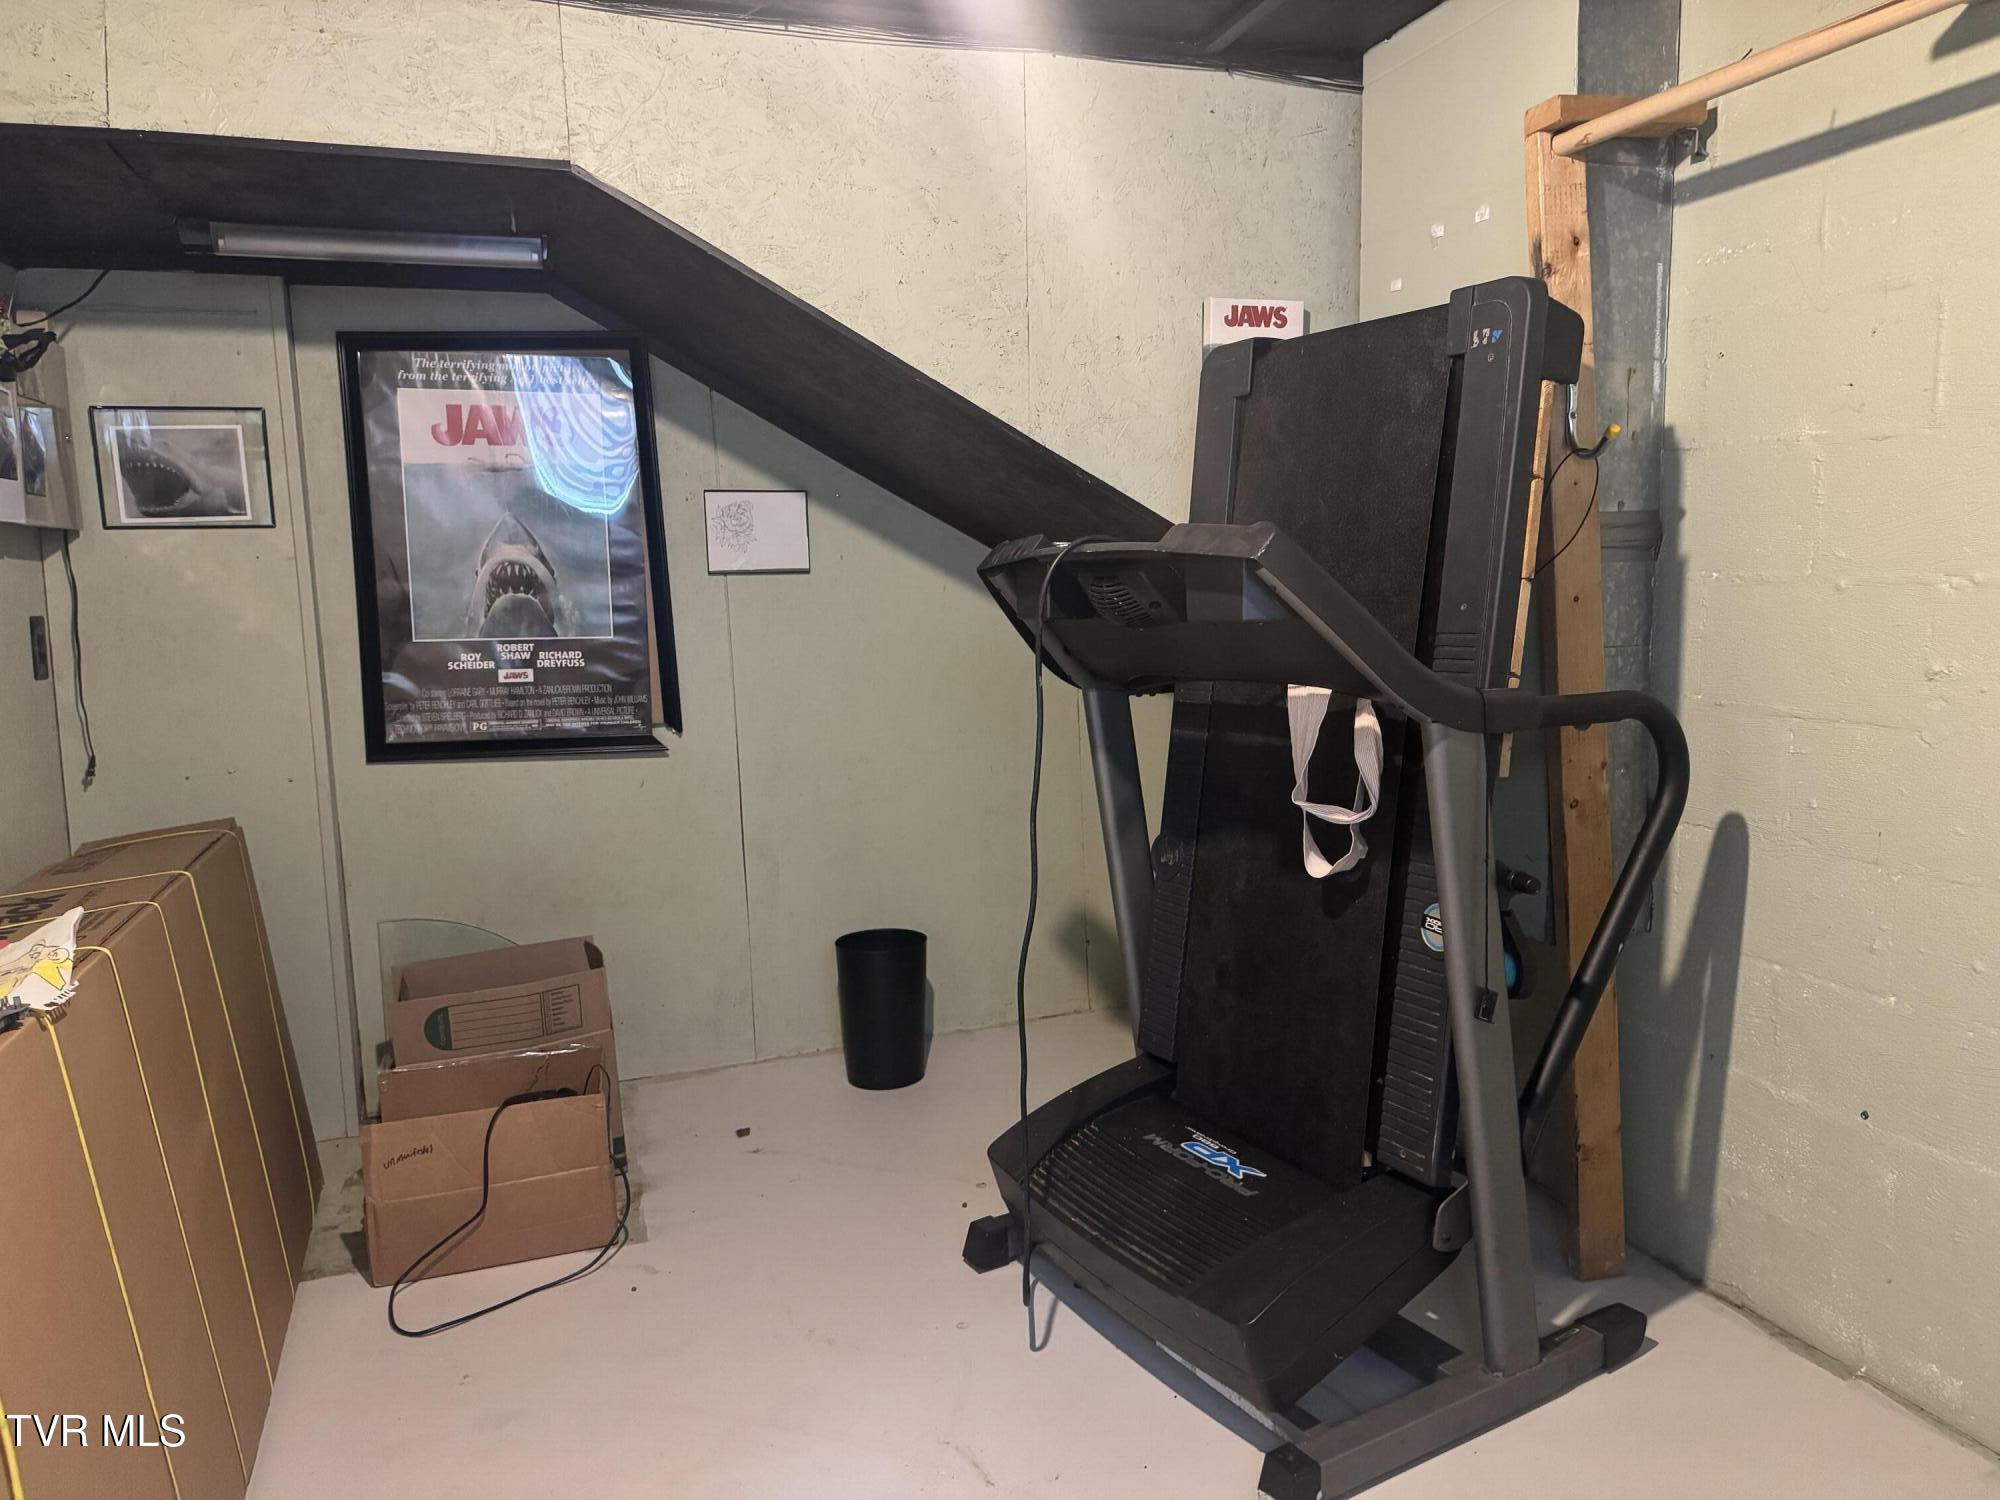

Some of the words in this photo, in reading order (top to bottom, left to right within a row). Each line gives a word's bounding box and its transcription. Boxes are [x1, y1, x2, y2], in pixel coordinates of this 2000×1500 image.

[1224, 304, 1288, 329] JAWS
[414, 357, 436, 369] The
[397, 369, 426, 381] from
[430, 371, 449, 381] the
[496, 643, 535, 652] ROBERT
[461, 653, 481, 661] ROY
[500, 651, 531, 660] SHAW
[539, 651, 582, 660] RICHARD
[448, 661, 495, 670] SCHEIDER
[537, 659, 585, 668] DREYFUSS
[503, 672, 529, 680] JAWS
[472, 721, 488, 732] PG
